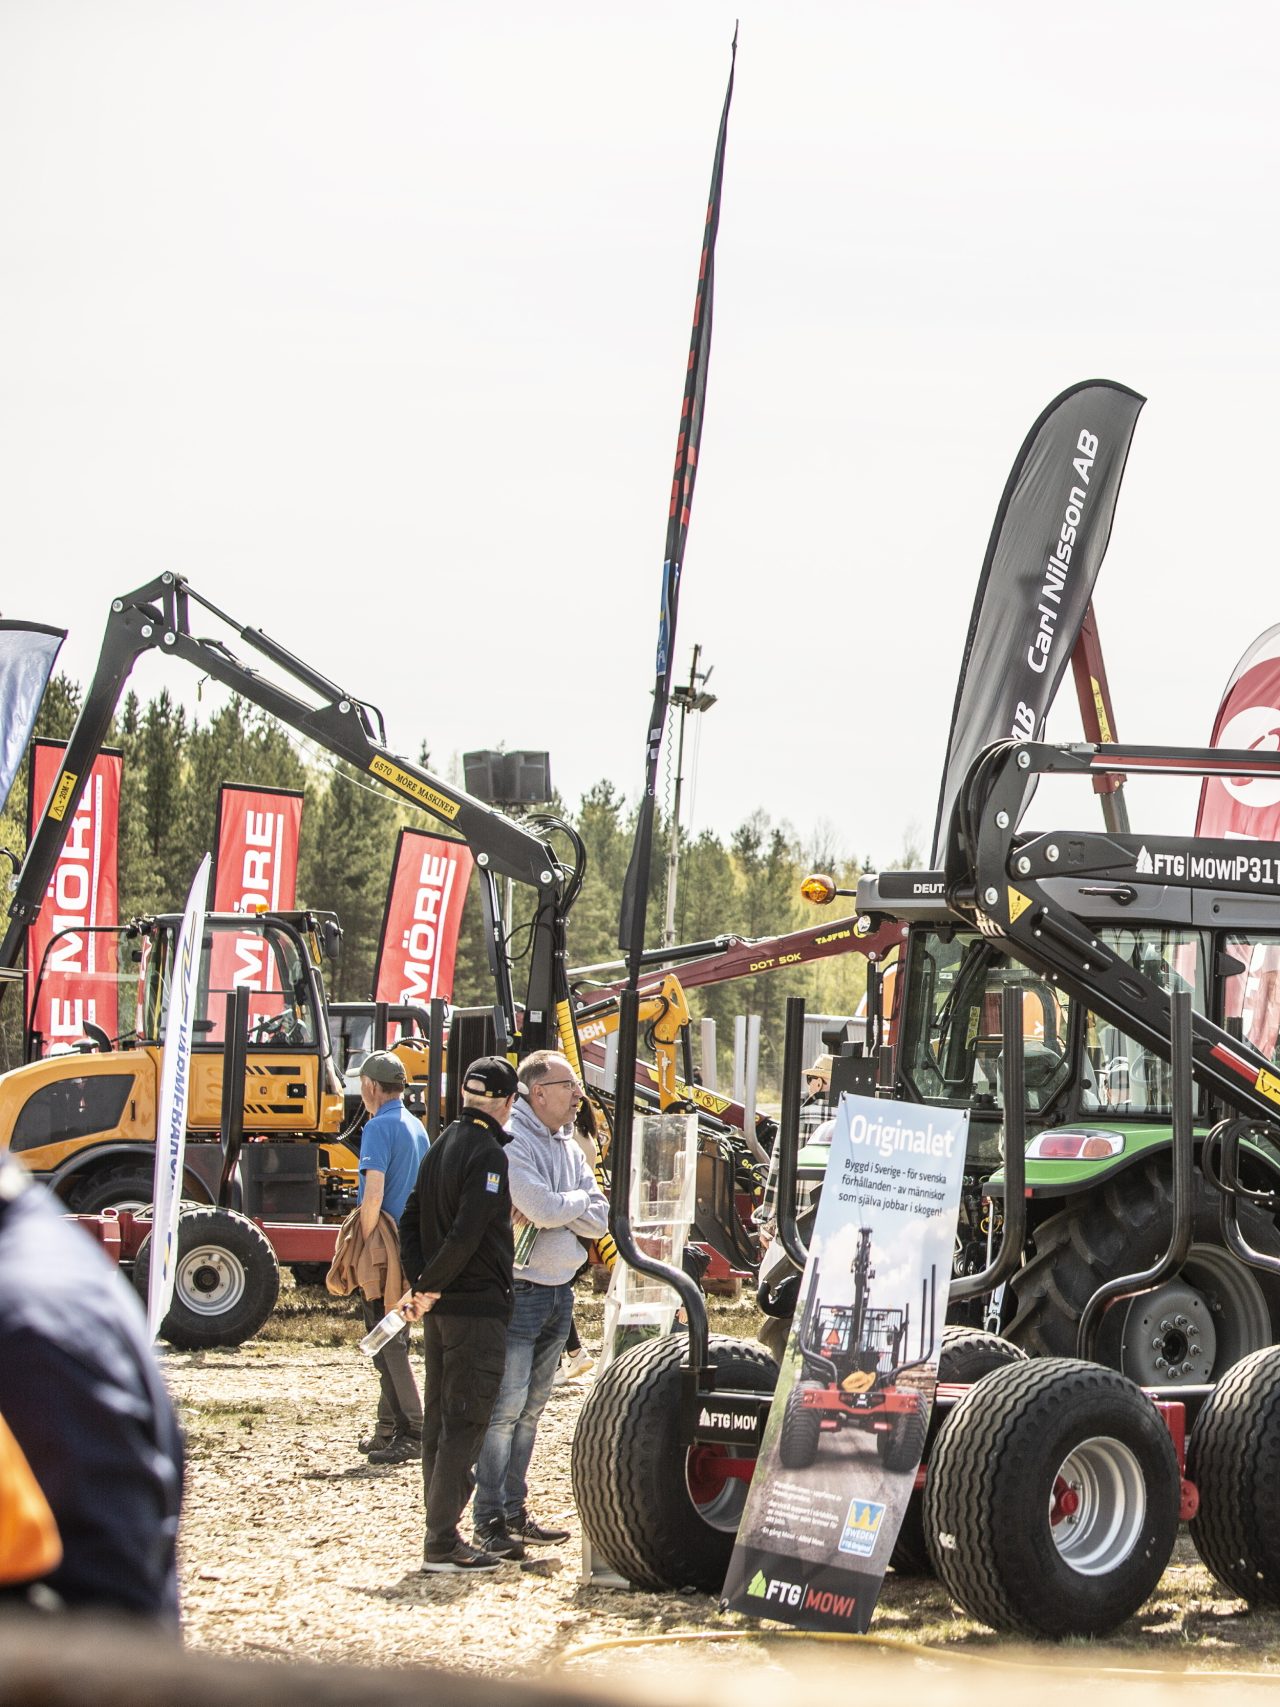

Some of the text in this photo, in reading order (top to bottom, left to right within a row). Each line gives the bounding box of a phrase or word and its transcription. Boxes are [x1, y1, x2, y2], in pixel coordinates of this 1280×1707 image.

[1027, 428, 1100, 674] Carl Nilsson AB
[374, 760, 455, 815] 6570 MÖRE MASKINER
[1154, 853, 1185, 877] FTG
[913, 883, 945, 894] DEUT
[400, 853, 448, 1006] MÖRE
[750, 952, 802, 972] DOT 50K
[850, 1114, 955, 1159] Originalet
[845, 1158, 869, 1174] Byggd
[870, 1163, 874, 1172] i
[874, 1163, 901, 1179] Sverige
[907, 1168, 918, 1180] för
[919, 1172, 947, 1184] svenska
[842, 1174, 892, 1192] förhållanden
[898, 1186, 907, 1194] av
[908, 1186, 946, 1201] människor
[838, 1192, 943, 1218] som själva jobbar i skogen!
[710, 1412, 731, 1429] FTG
[766, 1579, 855, 1617] FTG MOWI
